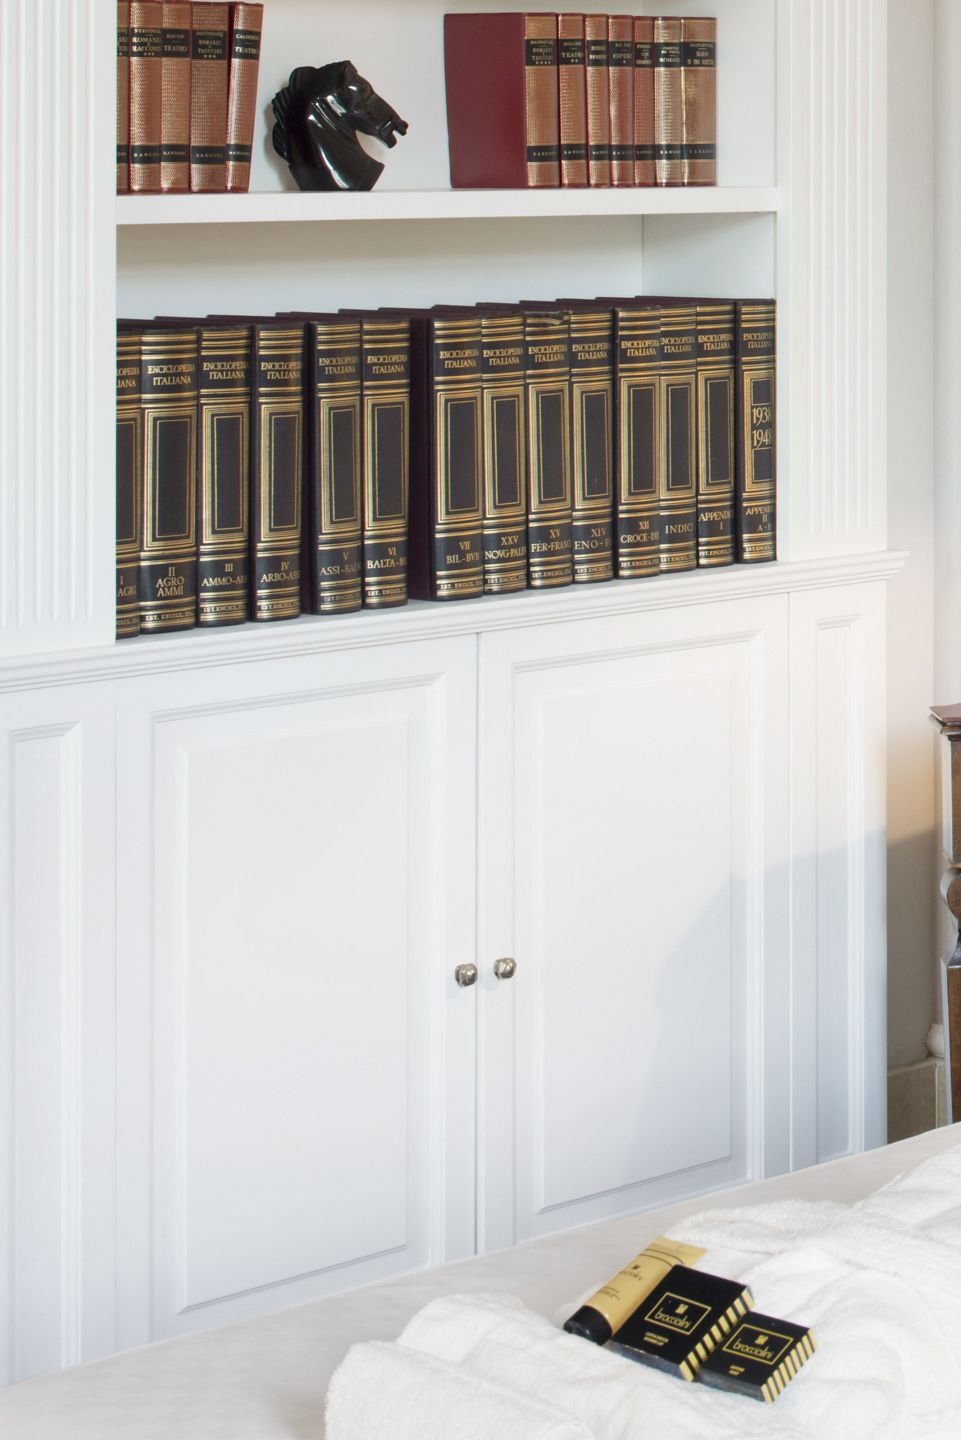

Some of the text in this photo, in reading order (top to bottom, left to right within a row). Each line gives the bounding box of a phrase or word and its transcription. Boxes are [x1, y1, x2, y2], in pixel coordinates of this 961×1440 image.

[663, 344, 692, 354] ITALIANA
[703, 341, 731, 352] ITALIANA
[534, 352, 565, 363] ITALIANA
[577, 350, 608, 361] ITALIANA
[626, 347, 657, 358] ITALIANA
[444, 358, 477, 369] ITALIANA
[489, 355, 520, 366] ITALIANA
[325, 365, 356, 376] ITALIANA
[372, 364, 405, 375] ITALIANA
[209, 370, 246, 381] ITALIANA
[267, 370, 301, 381] ITALIANA
[153, 376, 192, 387] ITALIANA
[639, 519, 650, 531] XII
[550, 528, 561, 539] XV
[590, 527, 607, 538] XIV
[459, 541, 471, 551] VII
[501, 535, 519, 546] XXV
[343, 551, 349, 561] V
[388, 546, 397, 556] VI
[168, 567, 176, 576] II
[224, 562, 234, 572] III
[280, 561, 289, 571] IV
[156, 576, 185, 589] AGRO
[157, 586, 184, 598] AMMI
